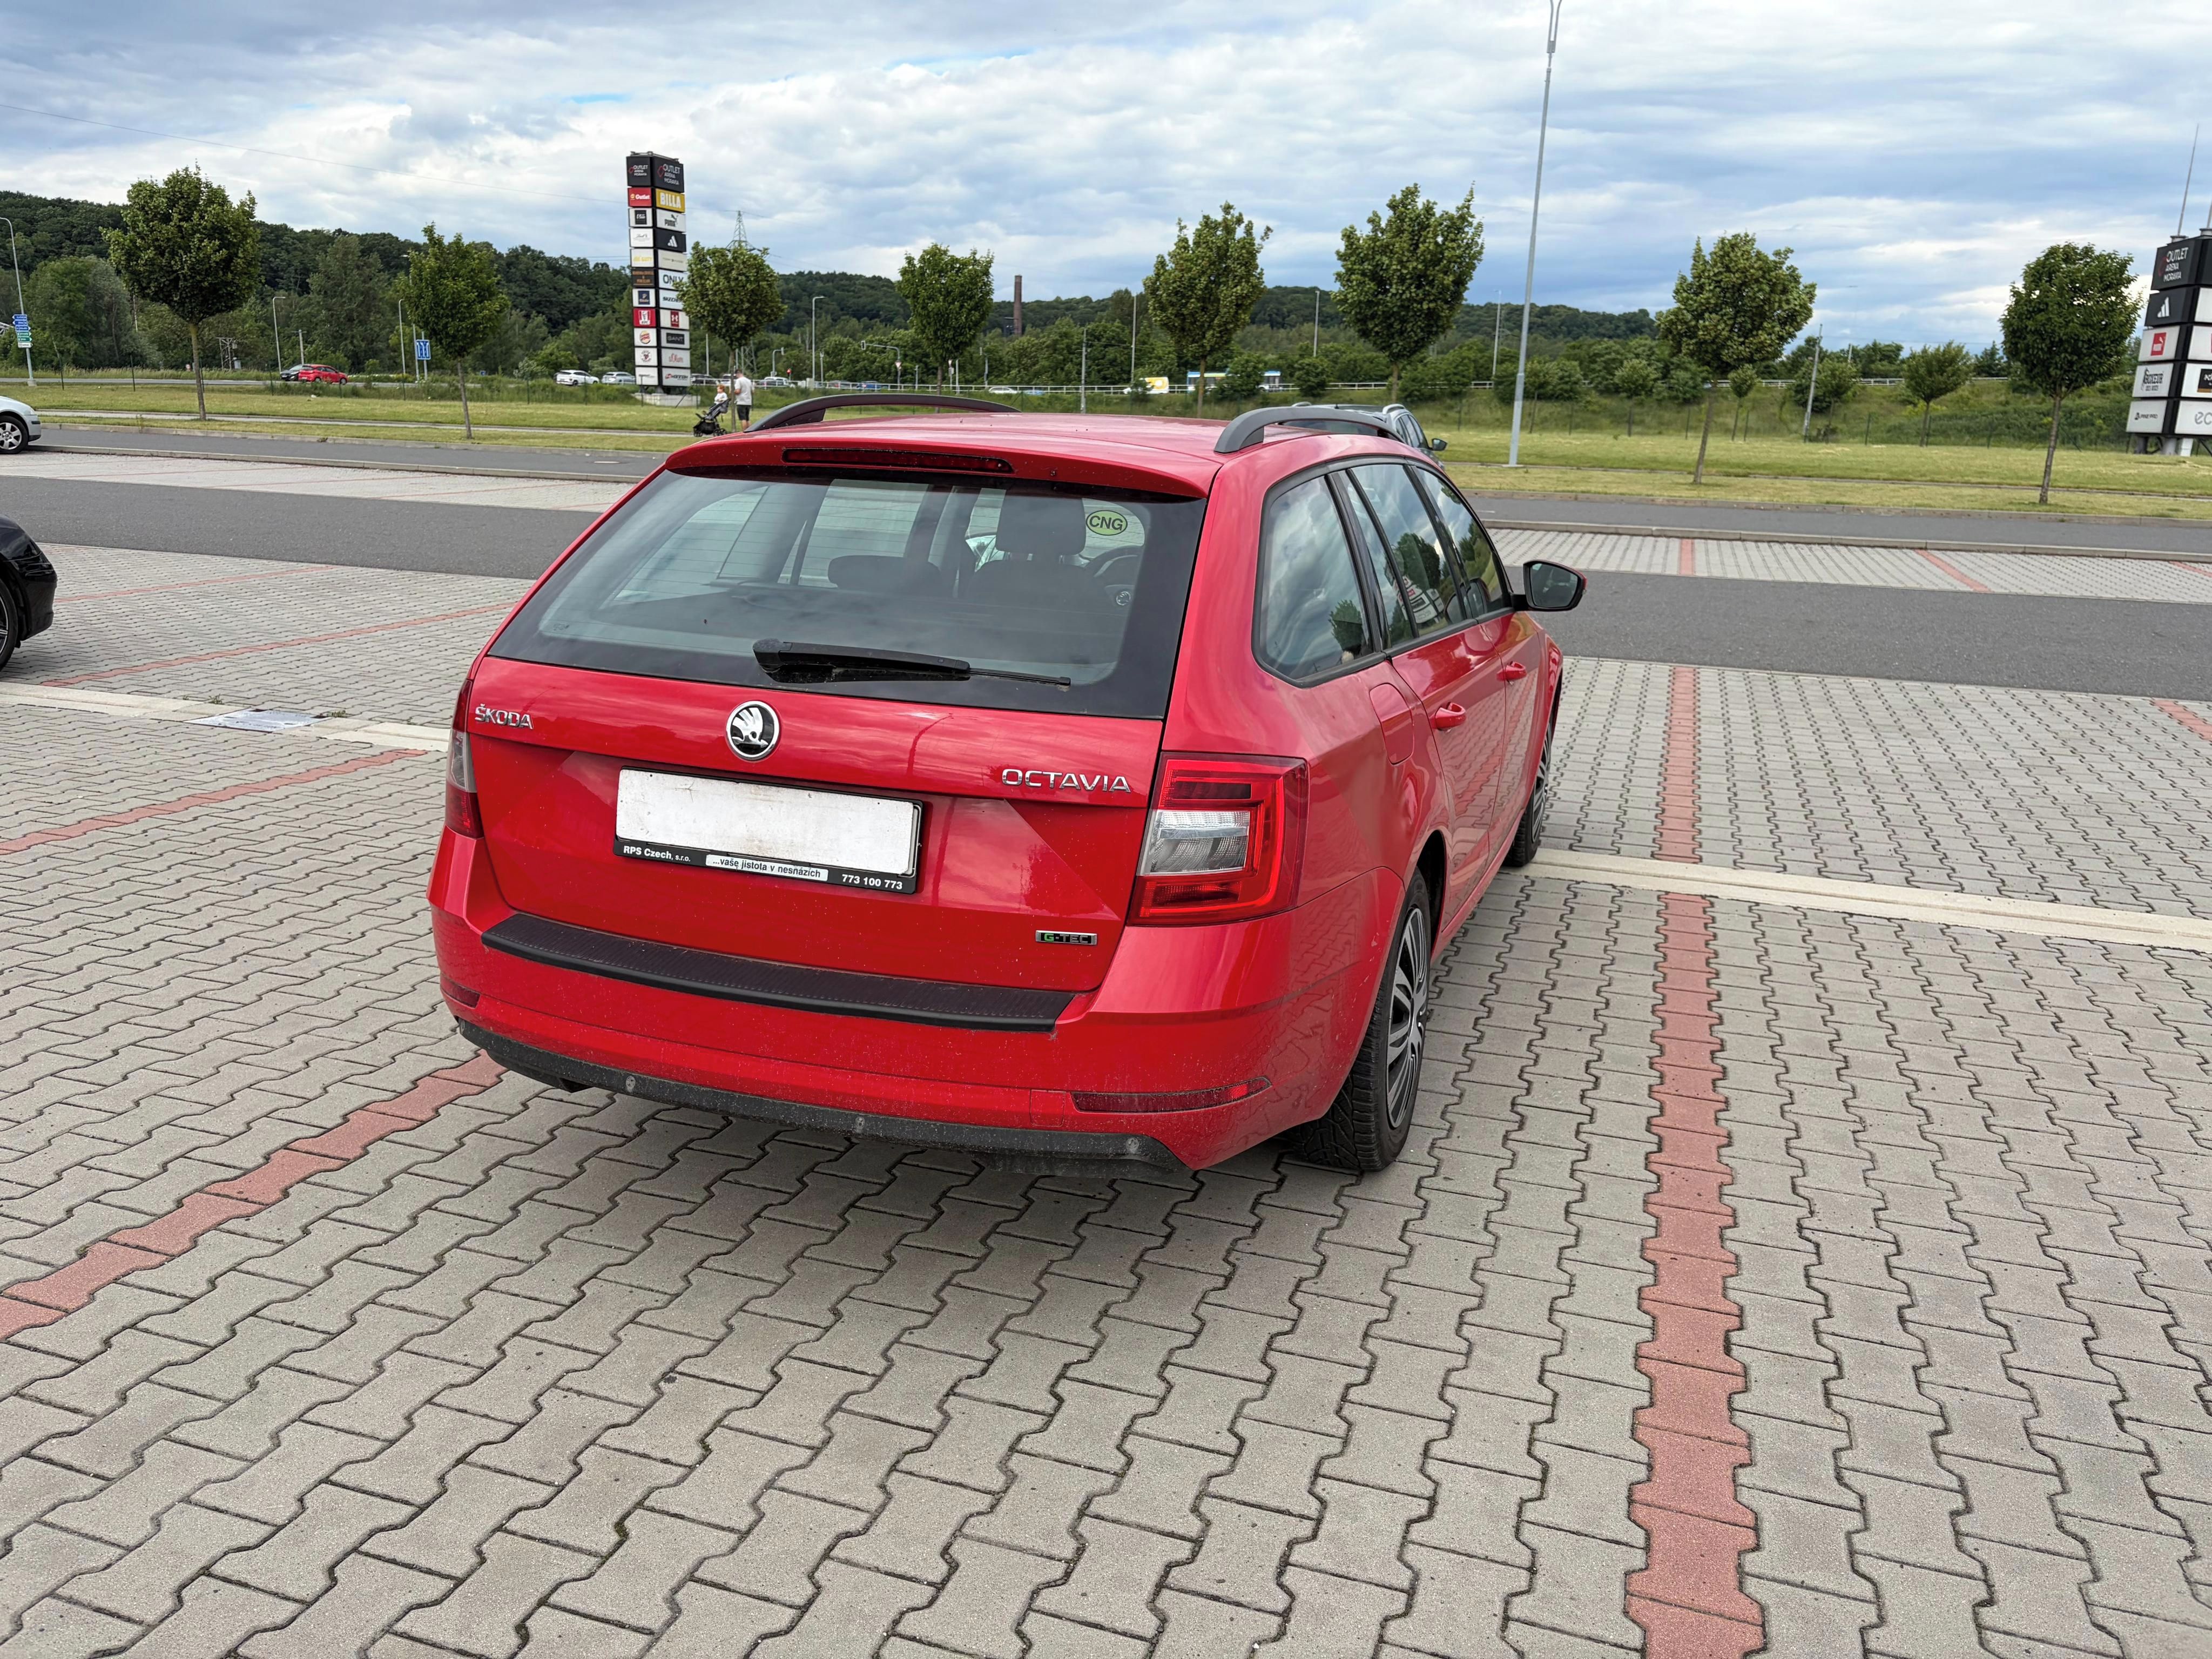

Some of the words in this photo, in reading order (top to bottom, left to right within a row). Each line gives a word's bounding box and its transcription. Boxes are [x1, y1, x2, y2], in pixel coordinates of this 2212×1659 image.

[663, 164, 680, 174] OUTLET
[660, 192, 682, 208] BILLA
[2166, 247, 2189, 262] OUTLET
[2165, 262, 2179, 272] ARENA
[2163, 272, 2182, 282] MORAVIA
[1089, 515, 1123, 531] CNG
[475, 703, 534, 730] ŠKODA
[1002, 768, 1131, 793] OCTAVIA
[623, 845, 642, 855] RPS
[644, 848, 673, 861] Czech,
[741, 859, 767, 871] jistota
[778, 866, 820, 878] nesnázích
[842, 874, 860, 884] 773
[863, 877, 881, 887] 100
[884, 879, 903, 890] 773
[1044, 933, 1089, 943] G-TEC
